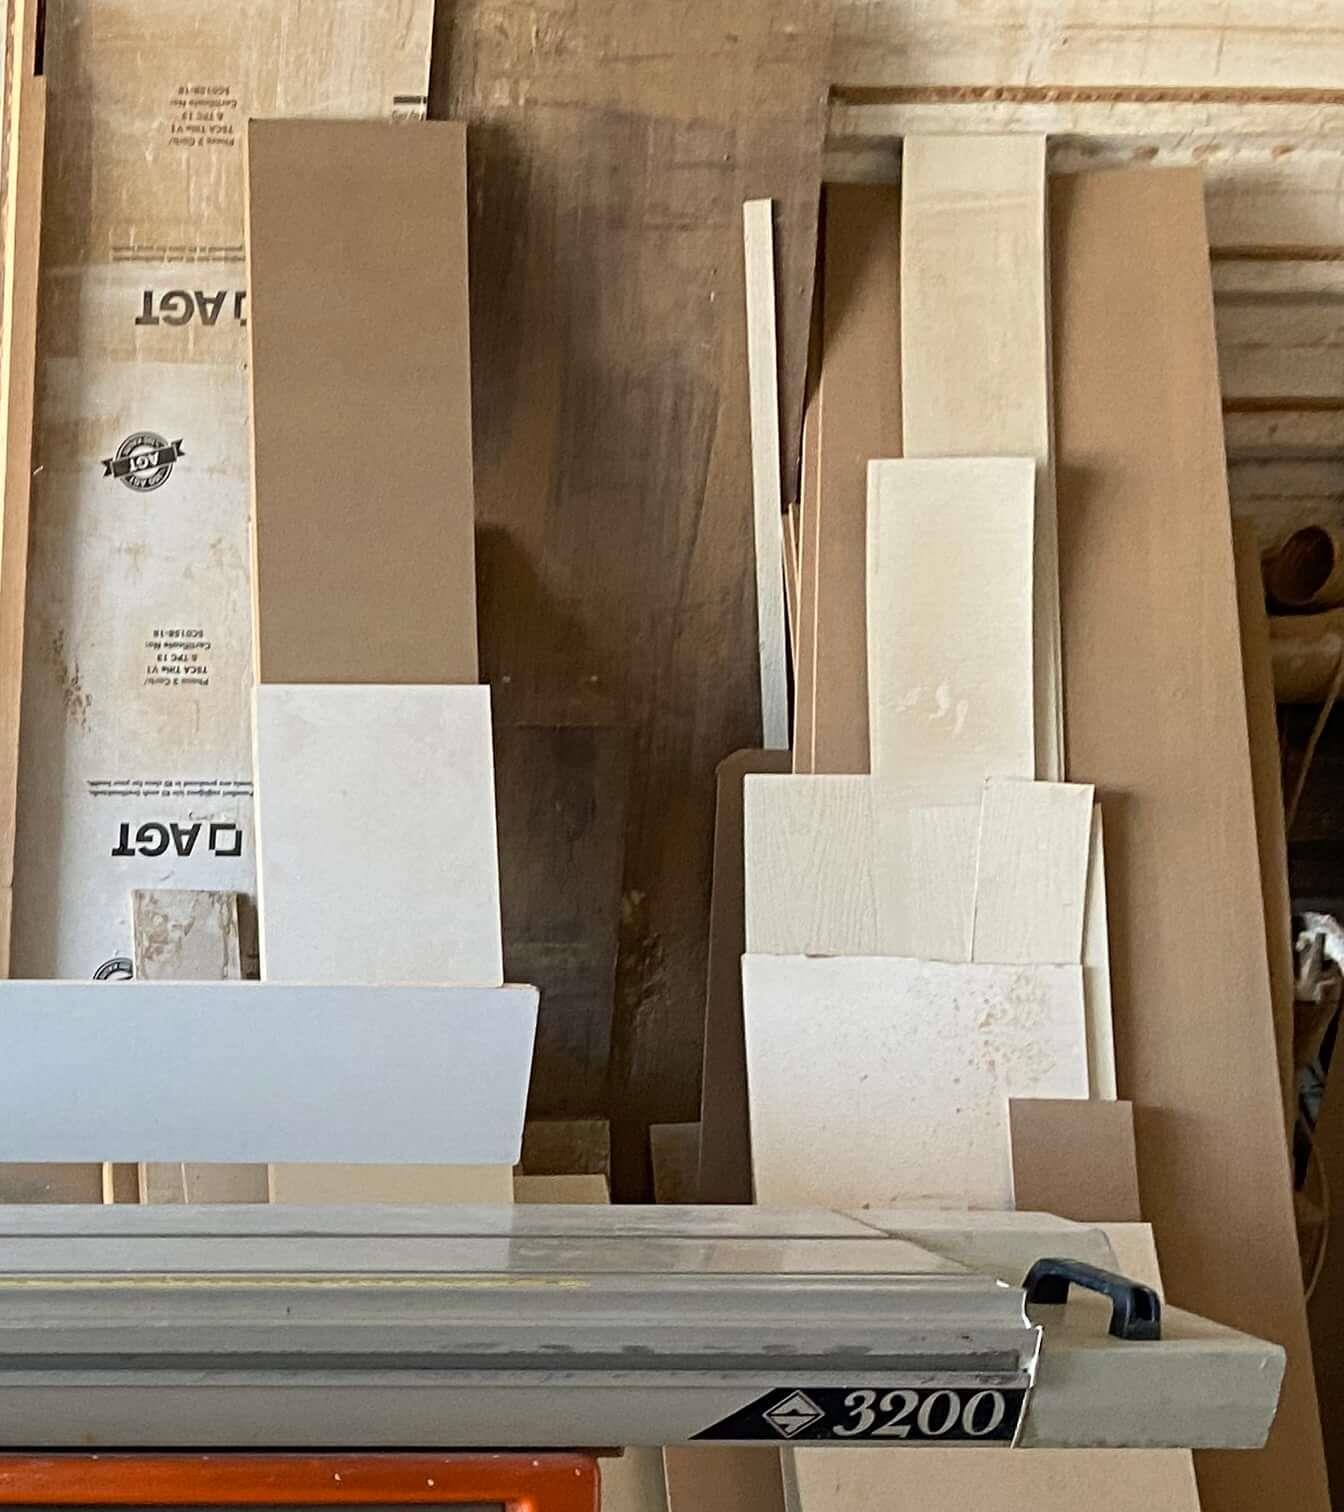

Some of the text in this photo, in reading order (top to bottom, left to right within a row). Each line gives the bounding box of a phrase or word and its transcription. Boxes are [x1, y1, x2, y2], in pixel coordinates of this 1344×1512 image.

[135, 290, 227, 327] AGT
[130, 451, 159, 472] AGT
[161, 666, 180, 674] Title
[184, 666, 208, 674] TSCA
[111, 822, 202, 857] AGT
[832, 1389, 1005, 1439] 3200
